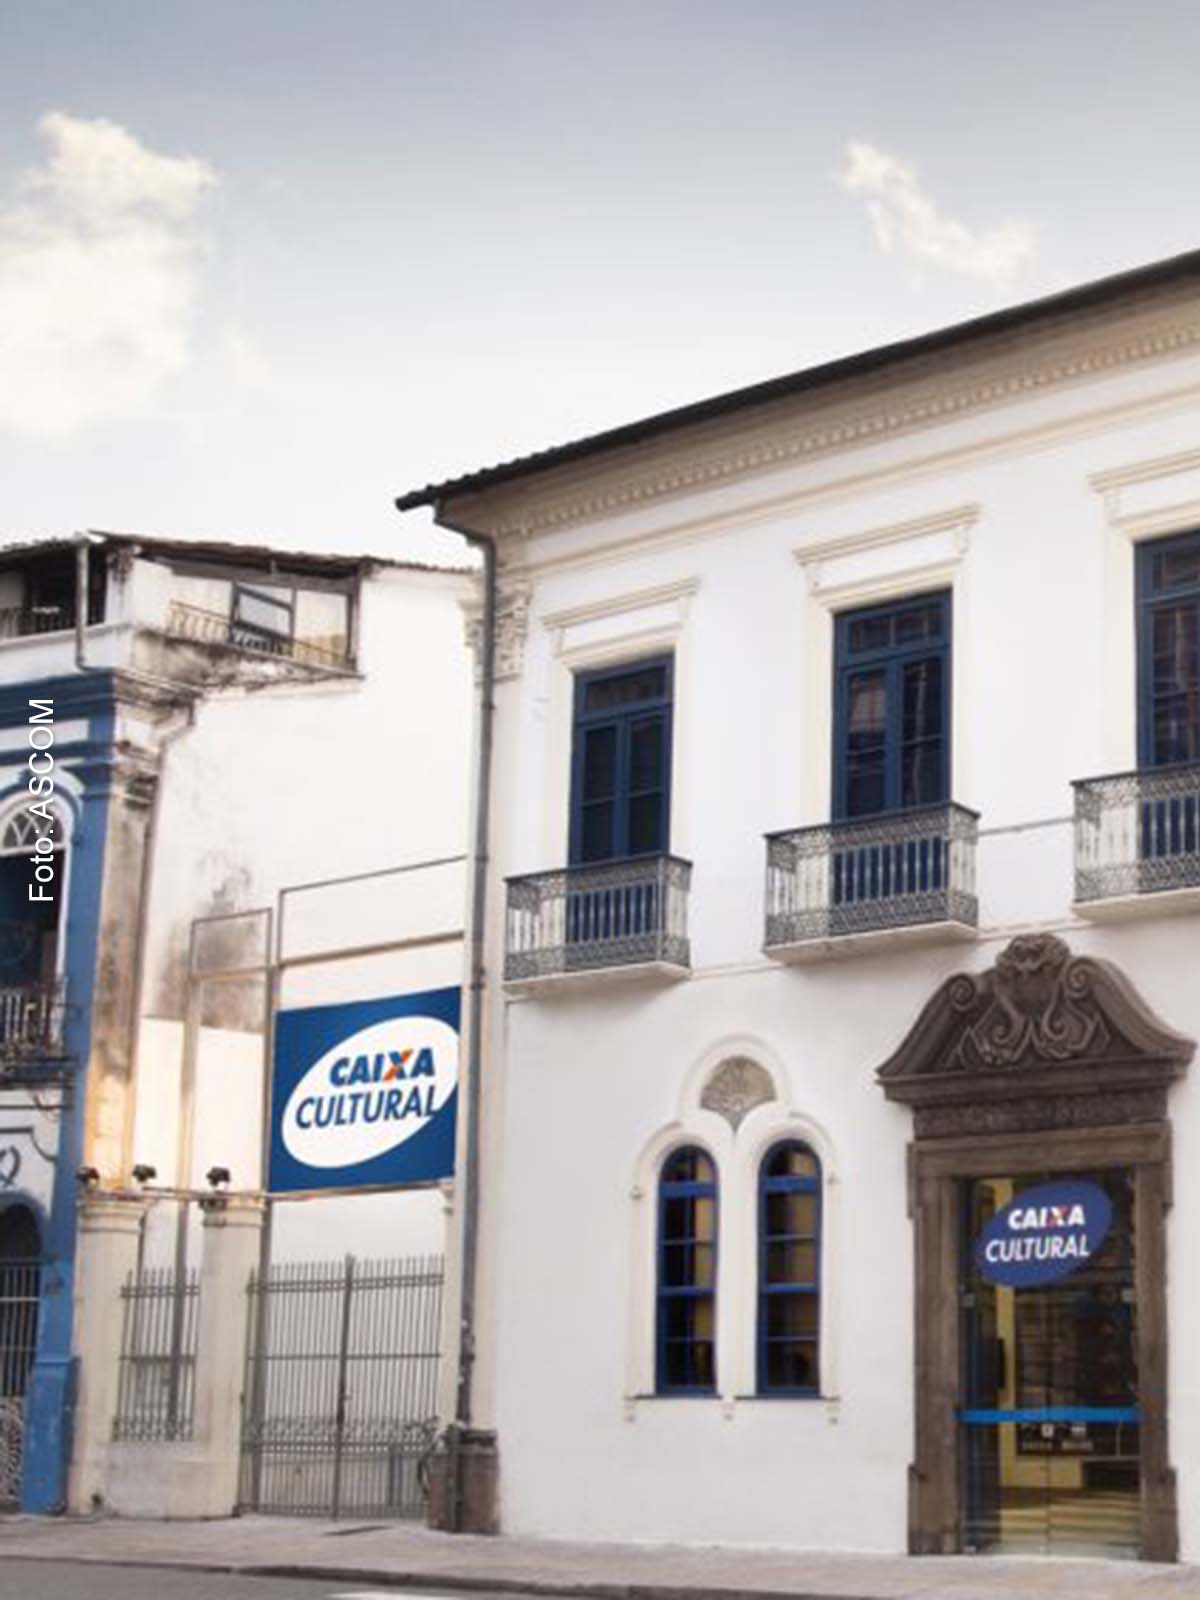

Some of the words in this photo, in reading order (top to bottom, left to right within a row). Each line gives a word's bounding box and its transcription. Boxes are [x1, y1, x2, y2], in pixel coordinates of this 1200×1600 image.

[330, 1047, 436, 1087] CAIXA
[296, 1086, 439, 1129] CULTURAL
[1008, 1204, 1086, 1230] CAIXA
[985, 1234, 1091, 1263] CULTURAL
